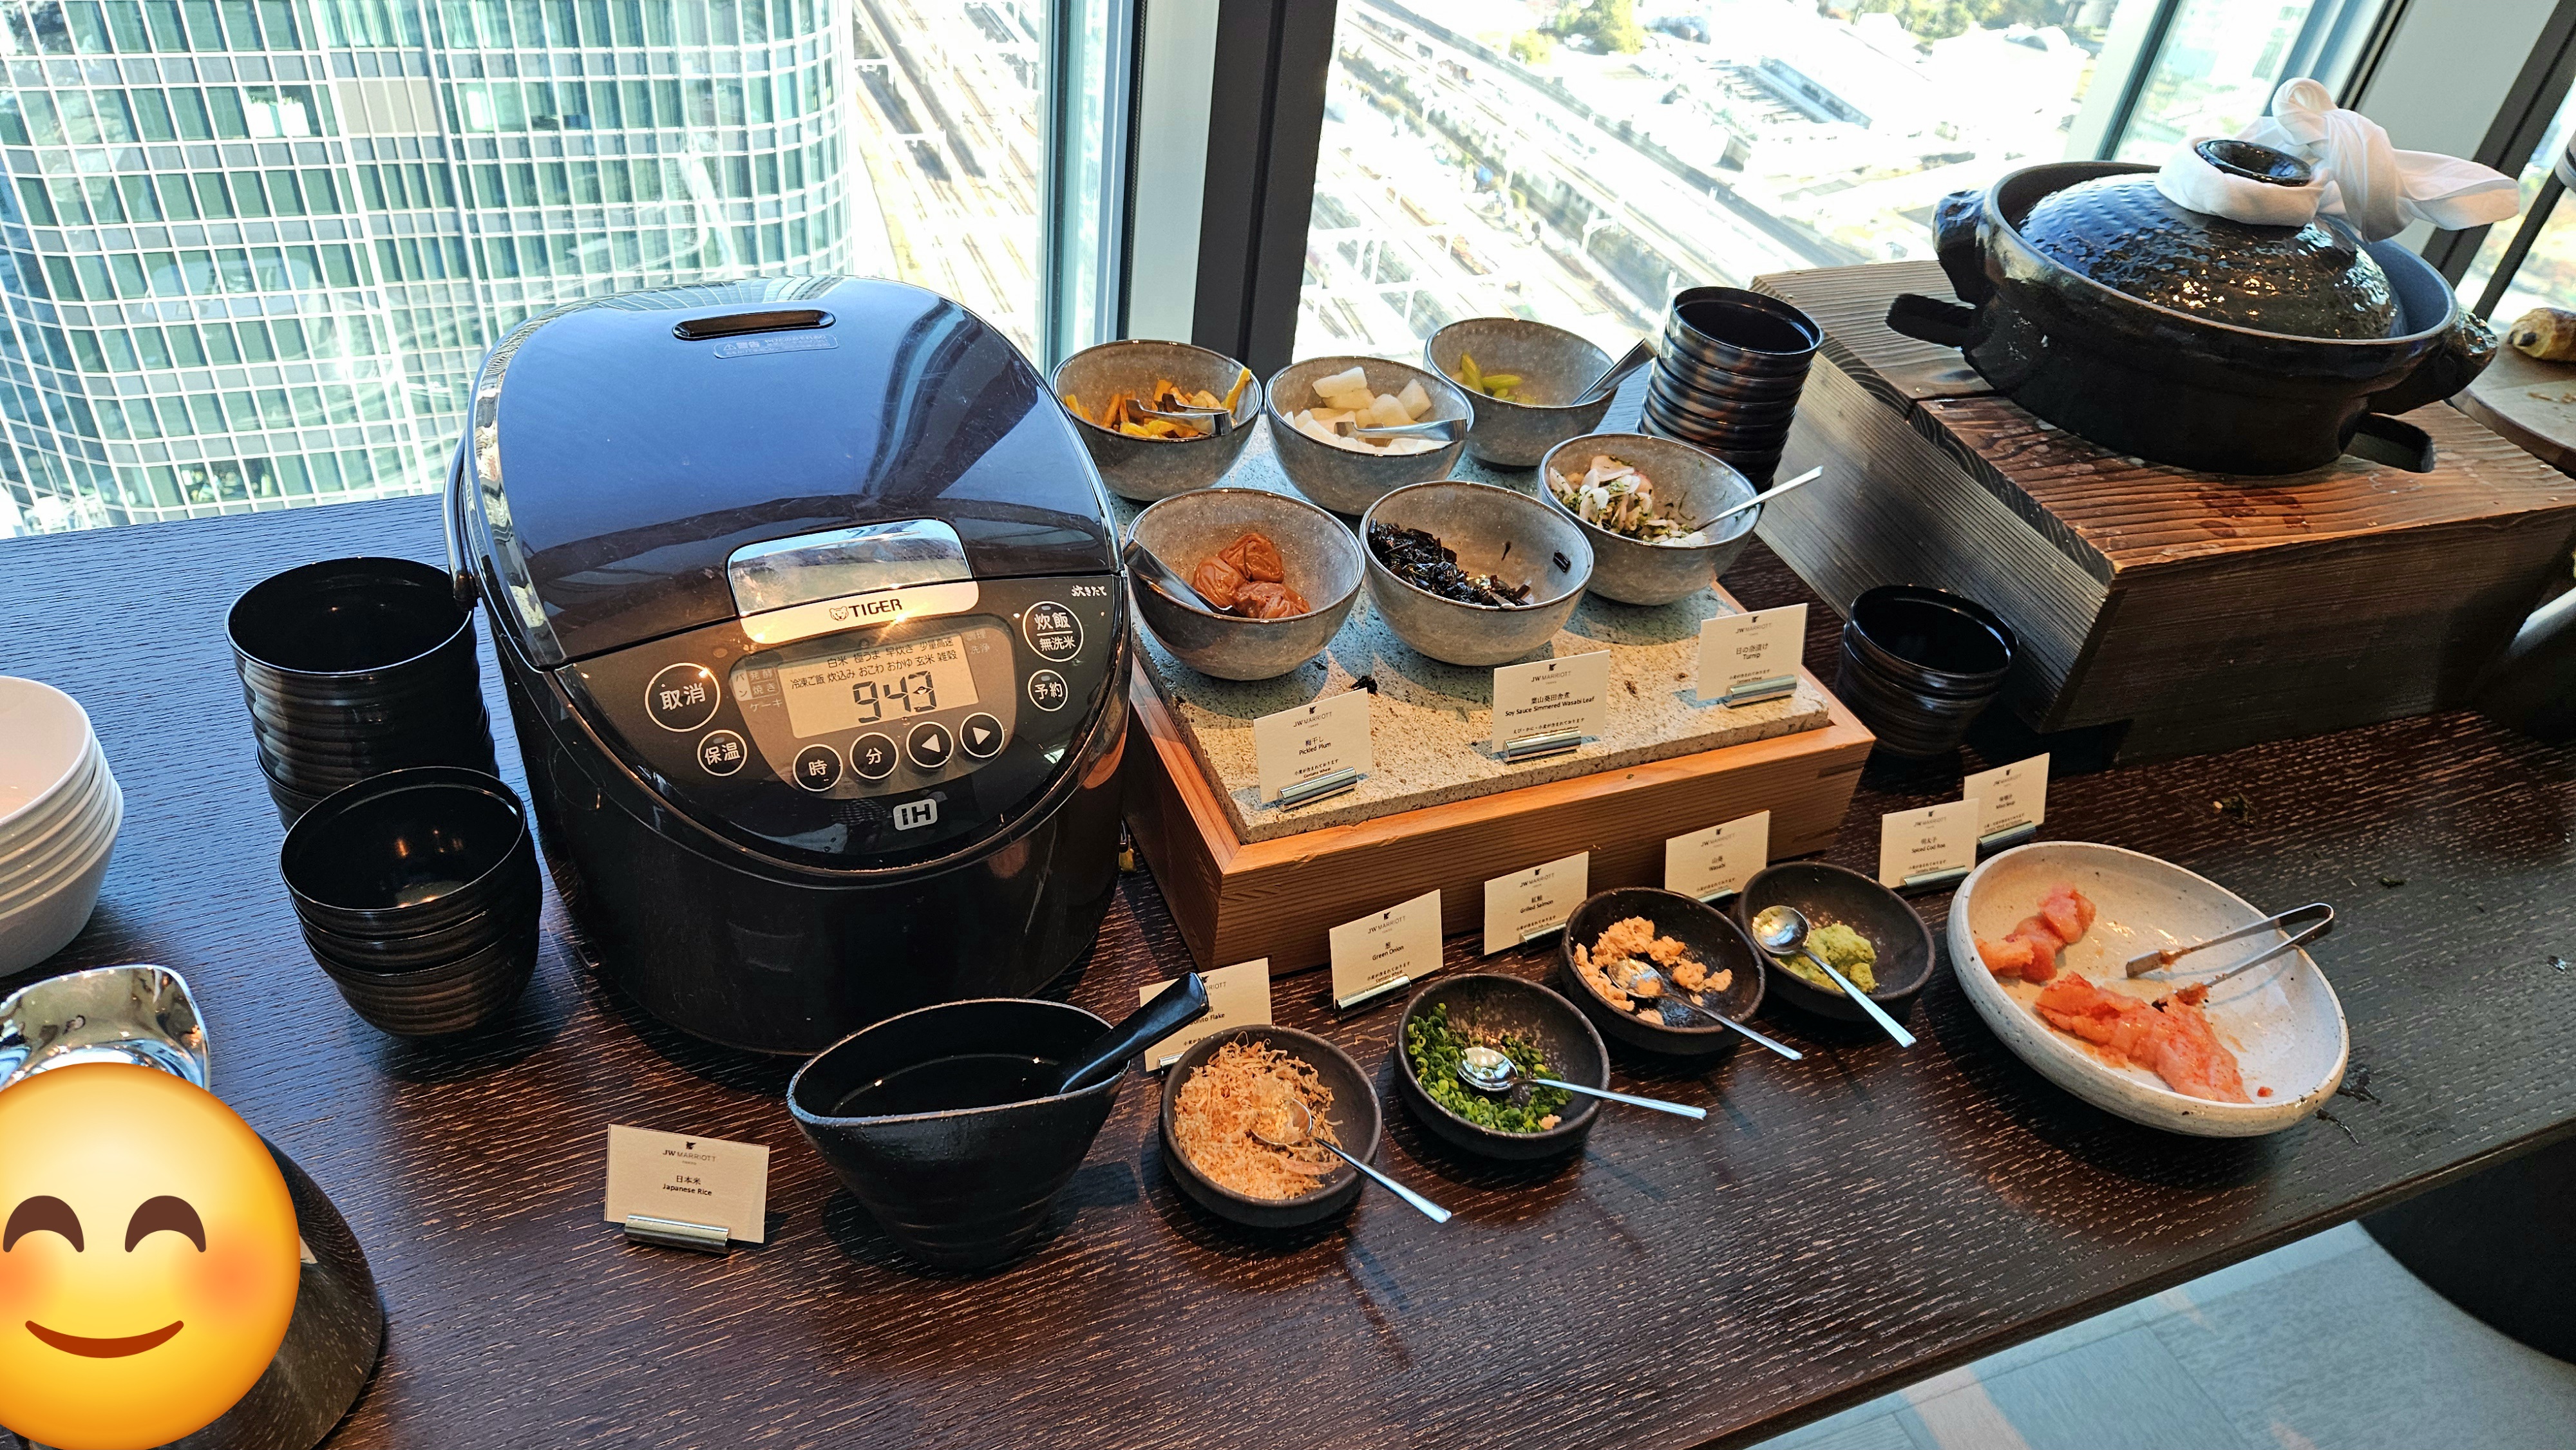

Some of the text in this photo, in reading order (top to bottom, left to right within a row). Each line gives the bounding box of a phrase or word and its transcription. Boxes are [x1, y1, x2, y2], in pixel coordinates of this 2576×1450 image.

[849, 599, 902, 617] TIGER
[1034, 612, 1071, 630] 炊飯
[971, 643, 990, 654] 洗浄
[1039, 636, 1076, 652] 無洗米
[827, 637, 954, 668] 白米 極うま 早炊き 少量高速
[791, 649, 958, 690] 冷凍ご飯 炊込み おこわ おかゆ 玄米 雑穀
[1542, 671, 1571, 681] MARRIOTT
[659, 682, 706, 710] 取消
[752, 683, 777, 695] 焼き
[1034, 682, 1063, 700] 予約
[750, 699, 782, 712] ケーキ
[1533, 703, 1560, 712] Simmered
[1562, 698, 1582, 707] Wasabi
[1582, 696, 1595, 704] Leaf
[1303, 711, 1332, 724] MARRIOTT
[705, 742, 741, 766] 保温
[866, 747, 882, 765] 分
[1299, 742, 1332, 755] Pickled Plum
[808, 759, 828, 777] 時
[901, 803, 932, 826] IH
[1378, 916, 1406, 930] MARRIOTT
[1372, 945, 1404, 961] Green Onion
[677, 1151, 716, 1162] MARRIOTT
[663, 1183, 696, 1193] Japanese
[676, 1175, 701, 1185] 日本米
